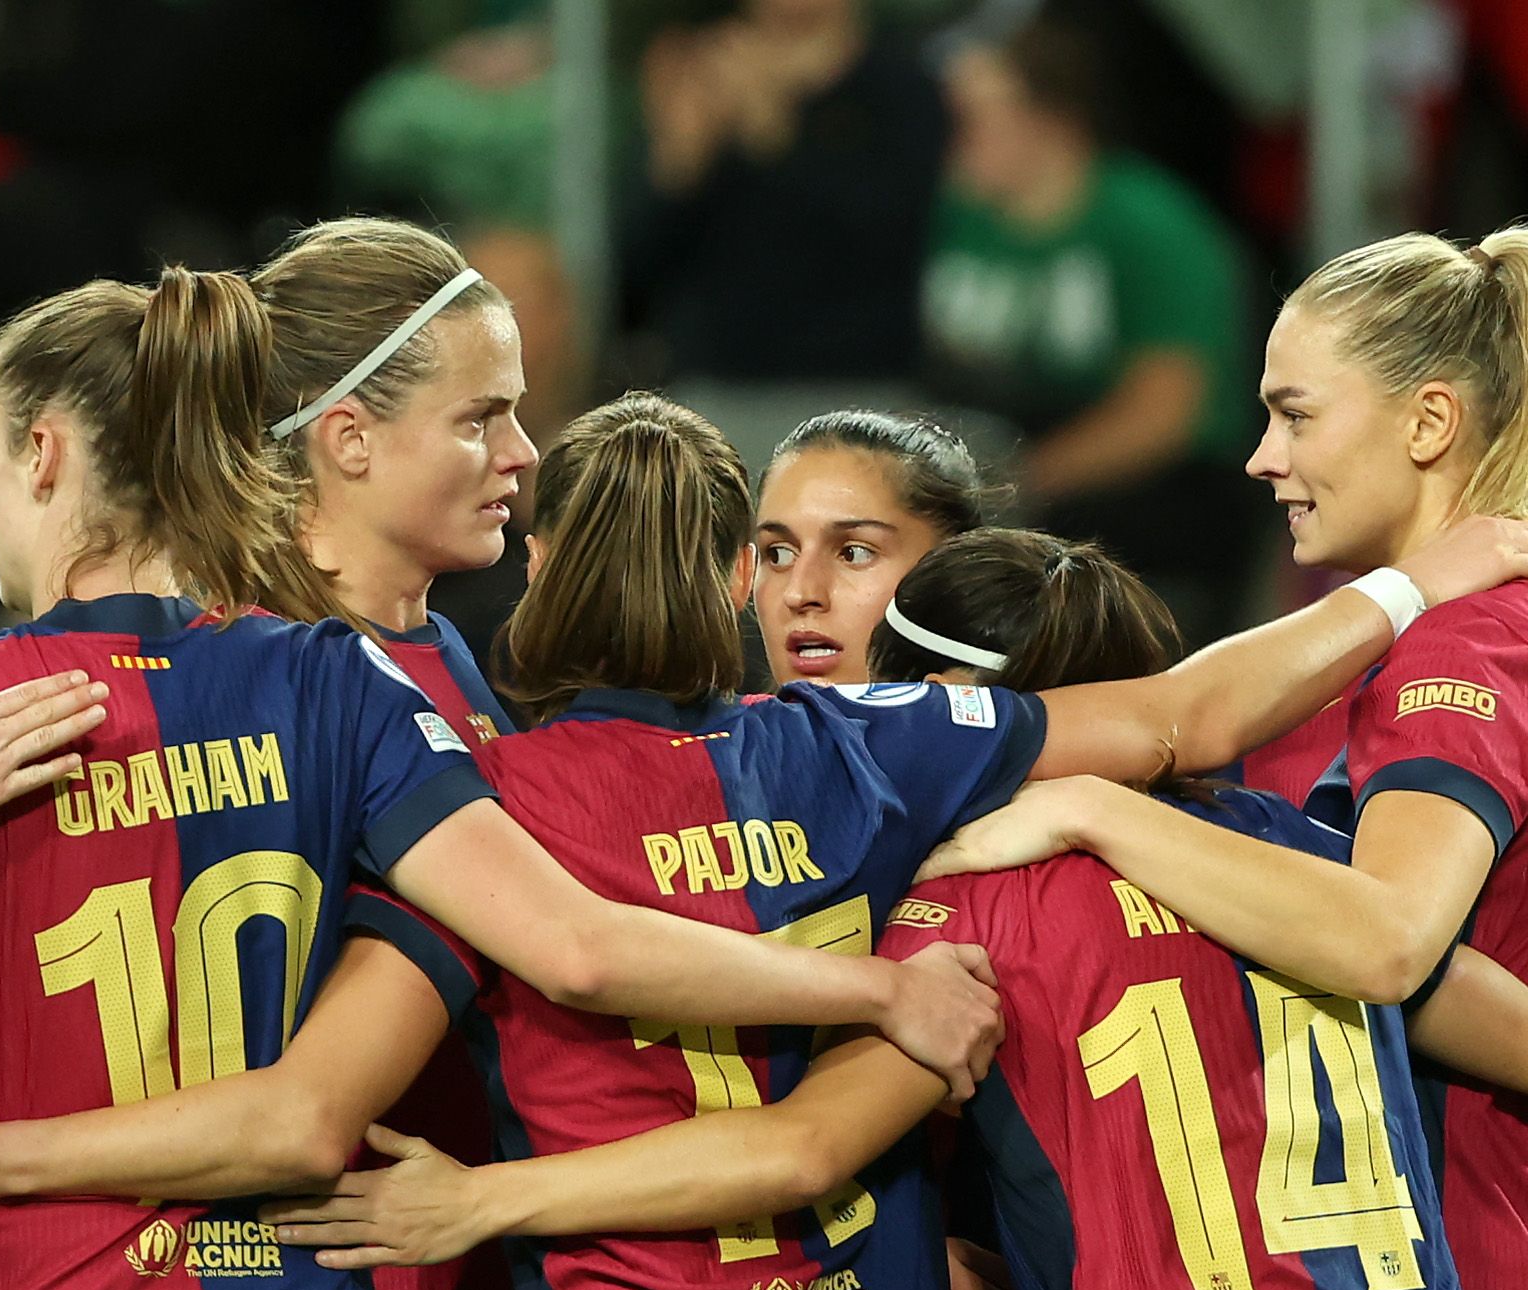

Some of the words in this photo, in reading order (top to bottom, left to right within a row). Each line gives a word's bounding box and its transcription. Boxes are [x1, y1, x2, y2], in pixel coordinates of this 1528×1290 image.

[1398, 683, 1496, 716] BIMBO
[53, 732, 290, 836] GRAHAM
[642, 818, 825, 896] PAJOR
[34, 850, 323, 1107] 10
[184, 1245, 282, 1268] ACNUR
[186, 1220, 279, 1244] UNHCR
